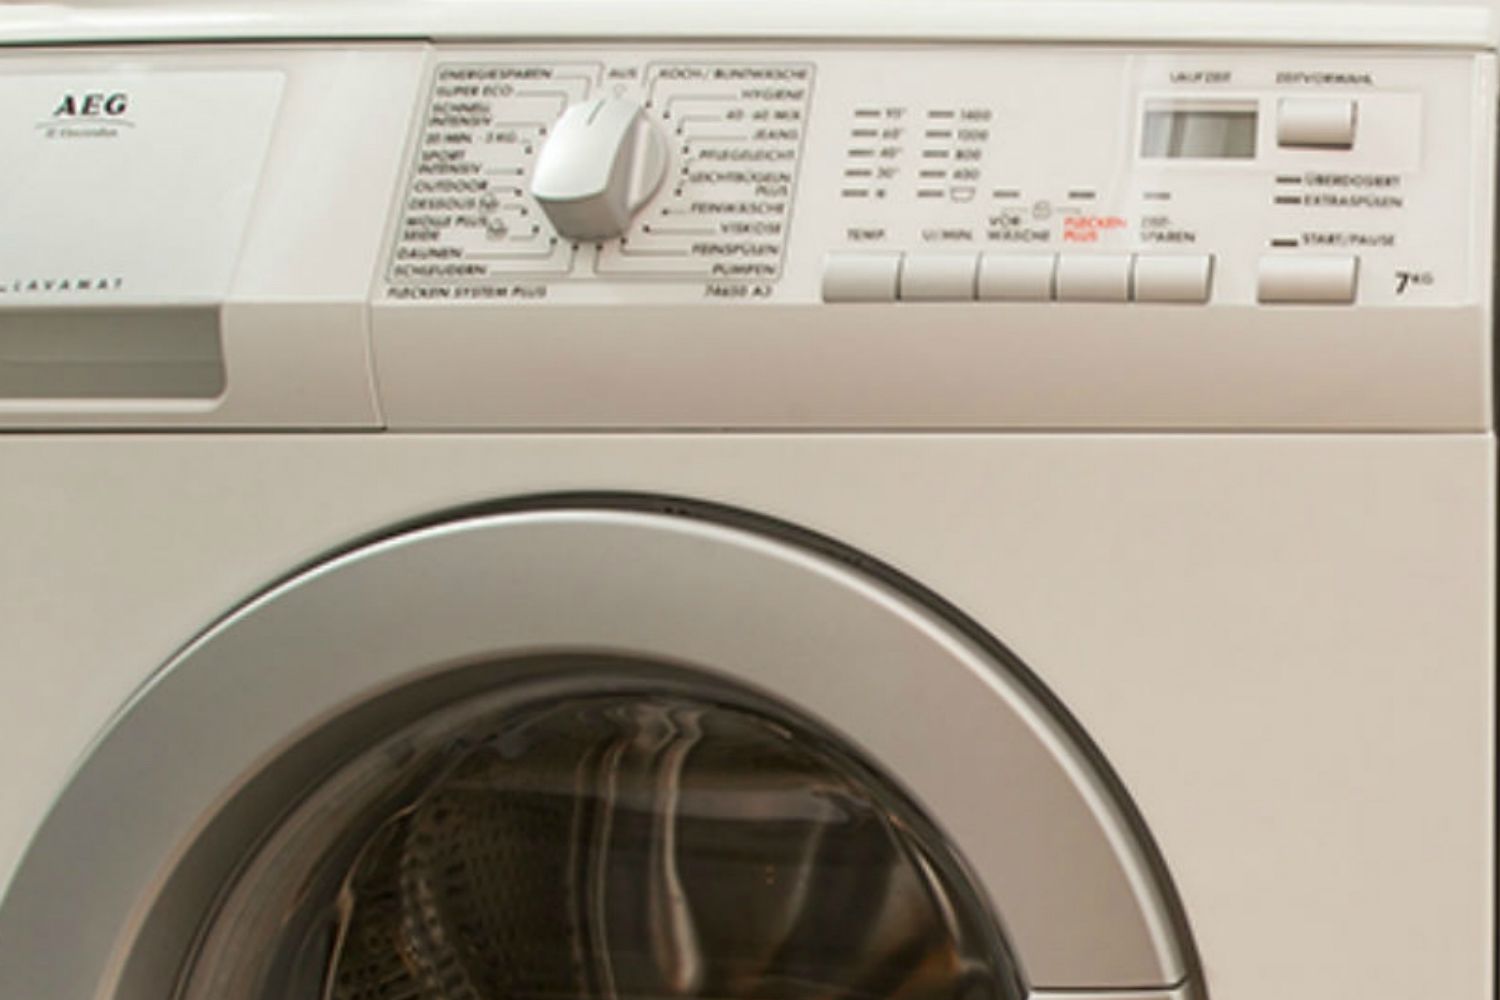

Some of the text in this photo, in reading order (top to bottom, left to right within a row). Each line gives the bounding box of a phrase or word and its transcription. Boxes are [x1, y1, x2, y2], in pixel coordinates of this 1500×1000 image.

[607, 68, 637, 79] AUS
[435, 84, 514, 97] SUPER ECO
[740, 88, 806, 100] HYGIENE
[52, 92, 128, 116] AEG
[1063, 214, 1128, 229] FLECKEN
[1063, 229, 1099, 242] PLUS
[1302, 232, 1396, 247] START/PAUSE
[13, 277, 123, 293] LAVAMAT
